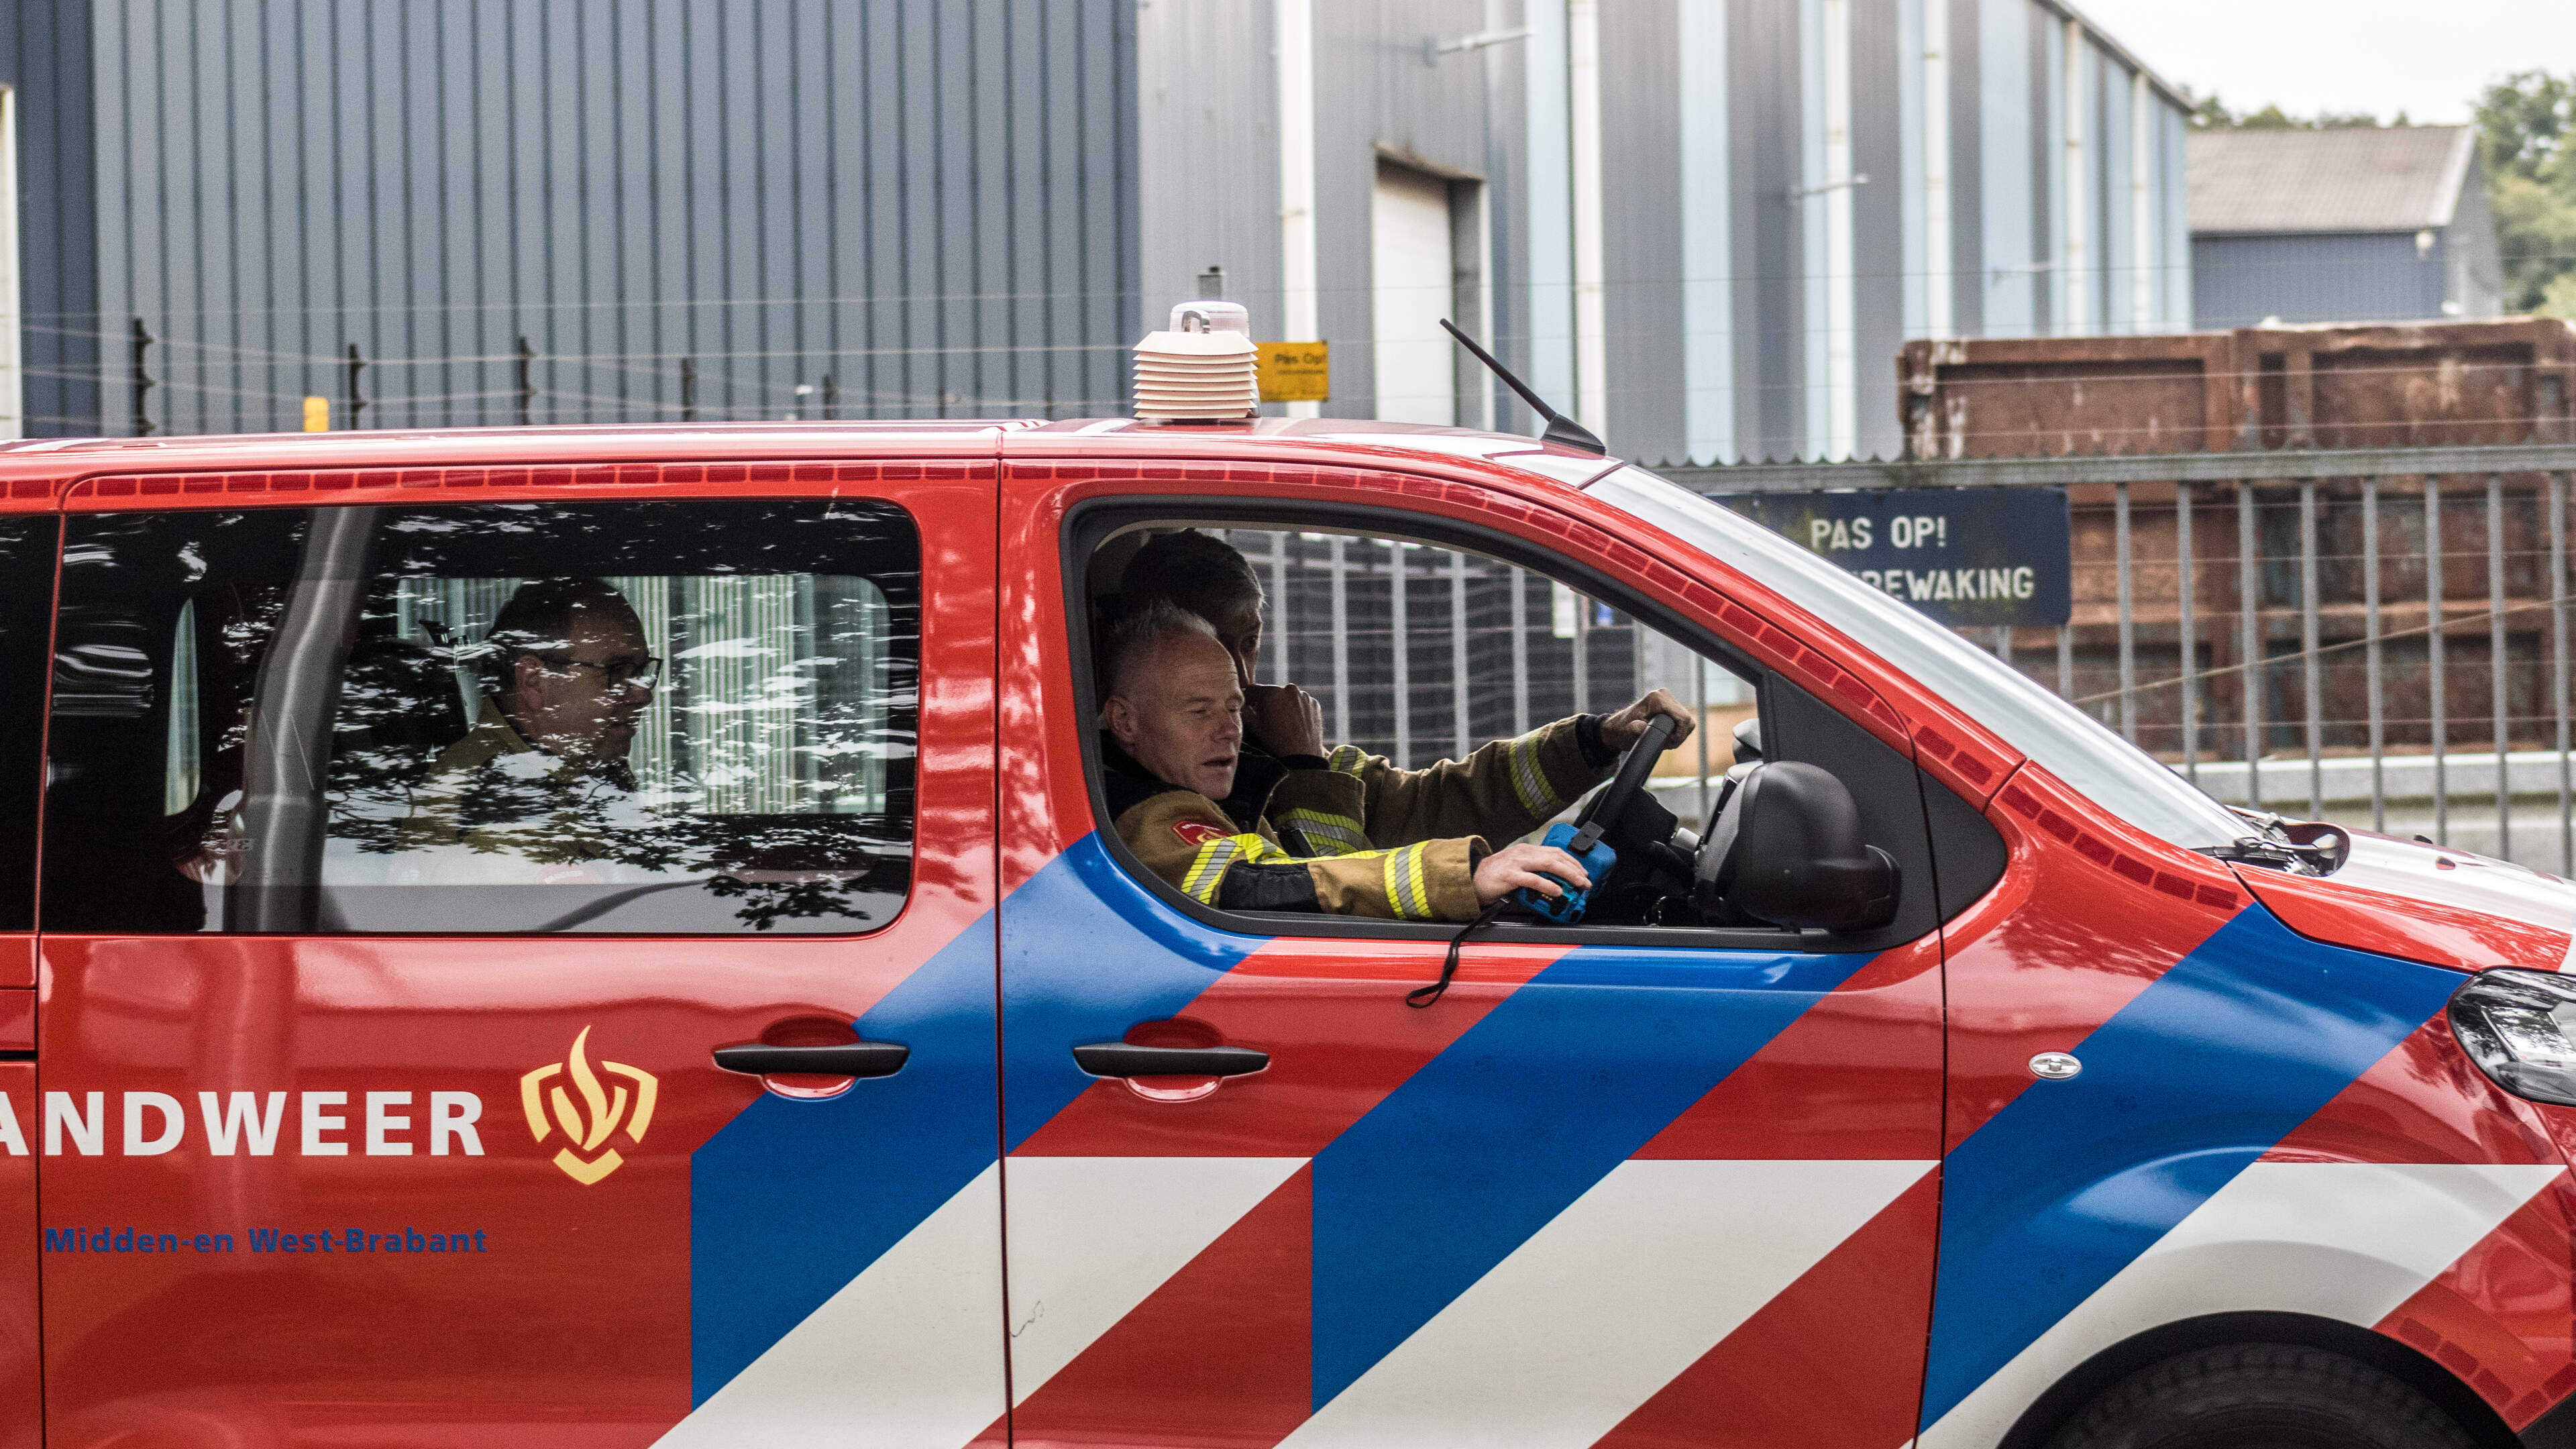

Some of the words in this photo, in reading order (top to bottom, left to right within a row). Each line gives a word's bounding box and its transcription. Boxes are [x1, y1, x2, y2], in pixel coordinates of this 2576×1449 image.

[1811, 516, 1872, 549] PAS
[1890, 515, 1947, 549] OP!
[45, 1226, 234, 1252] Midden-en
[248, 1226, 488, 1252] West-Brabant
